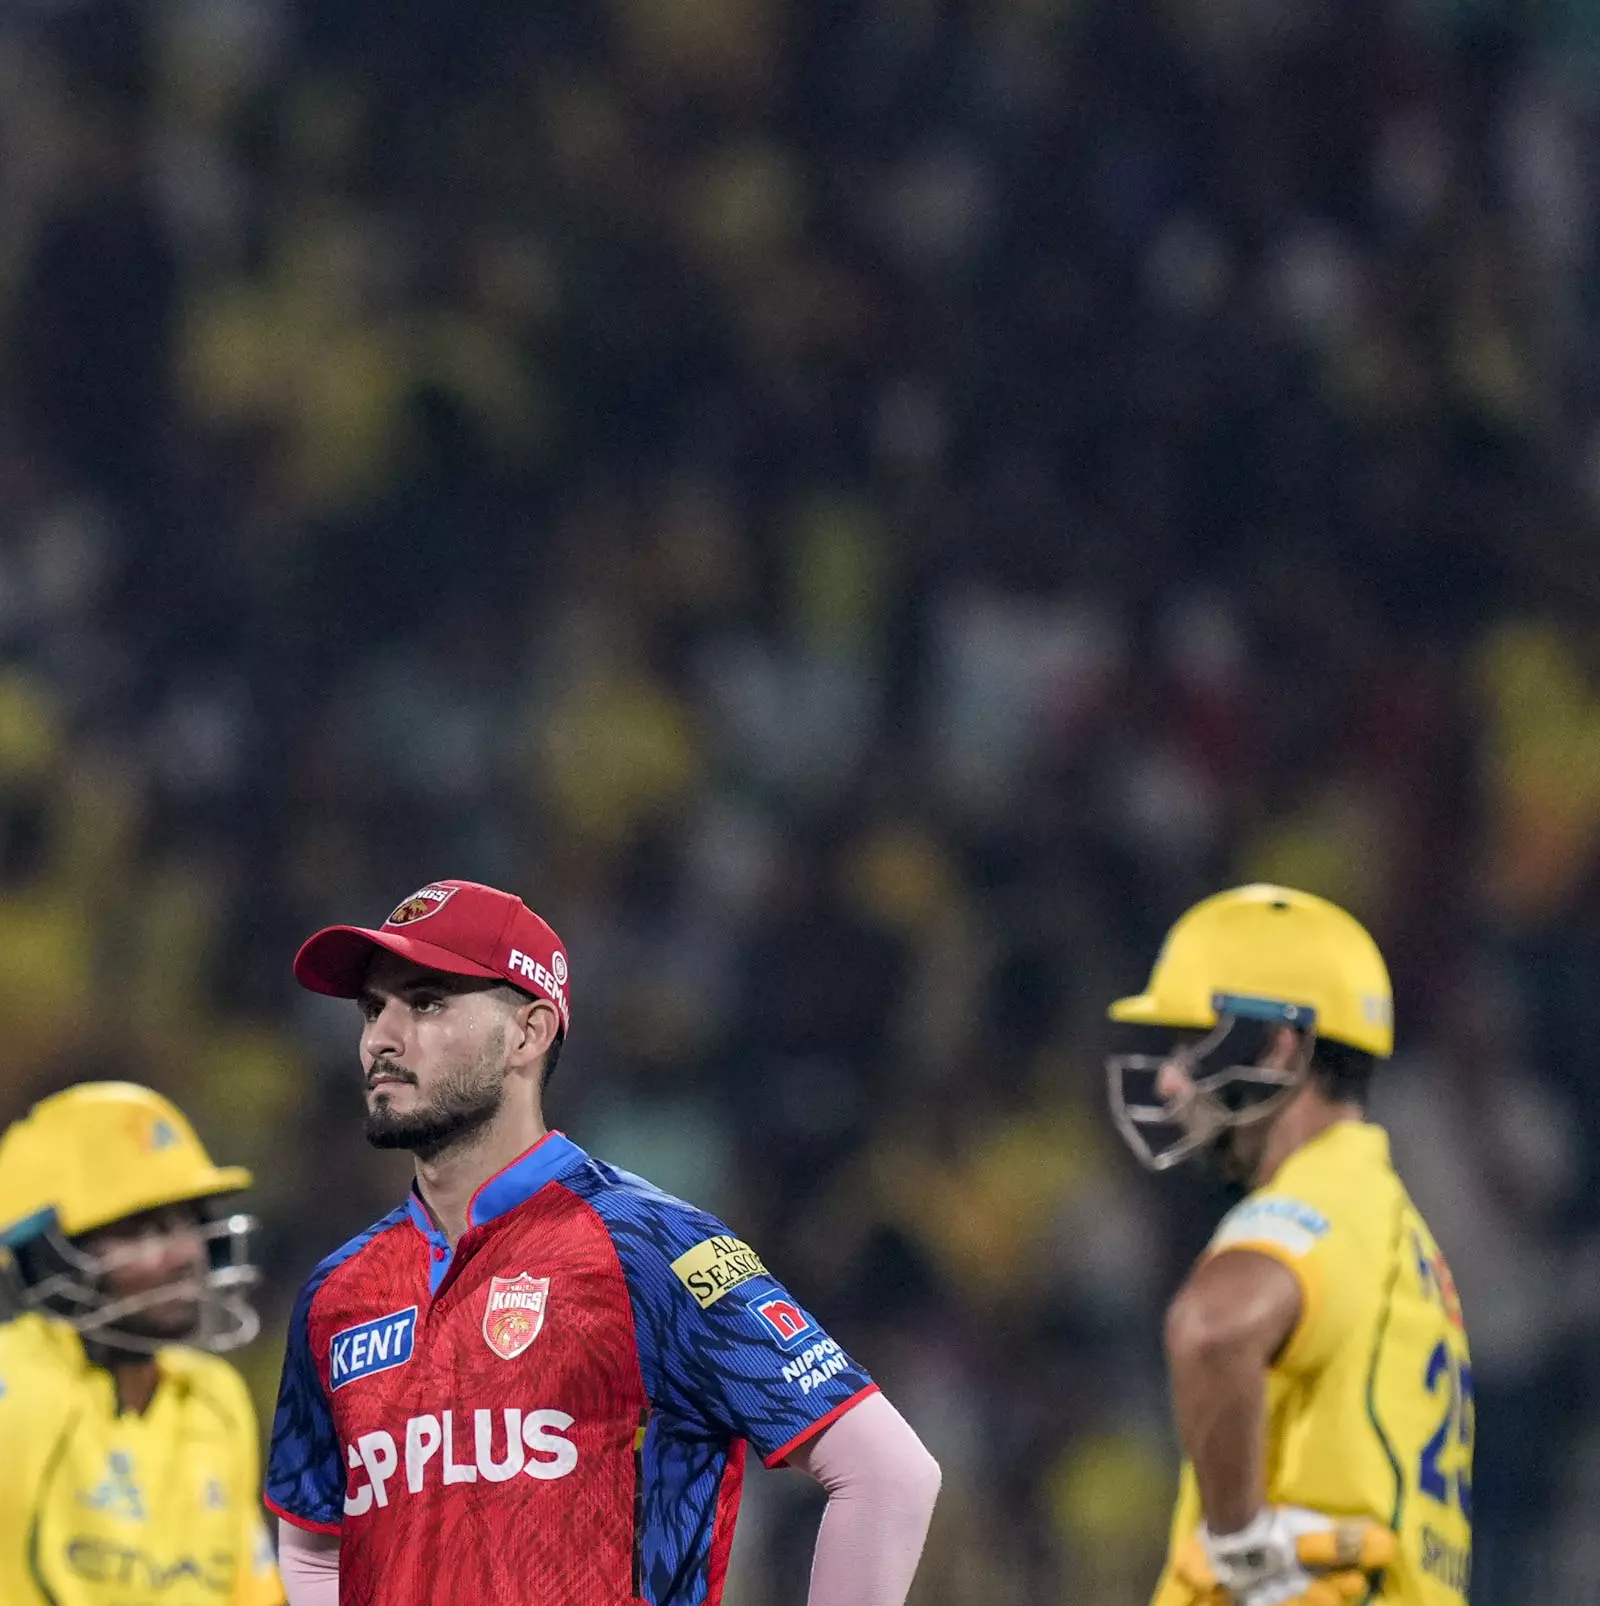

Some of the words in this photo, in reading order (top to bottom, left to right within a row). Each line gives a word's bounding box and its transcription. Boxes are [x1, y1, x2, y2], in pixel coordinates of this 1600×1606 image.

[492, 1291, 542, 1312] KINGS
[332, 1319, 410, 1379] KENT
[799, 1352, 849, 1394] PAINT
[343, 1430, 398, 1517] CP
[405, 1408, 578, 1494] PLUS
